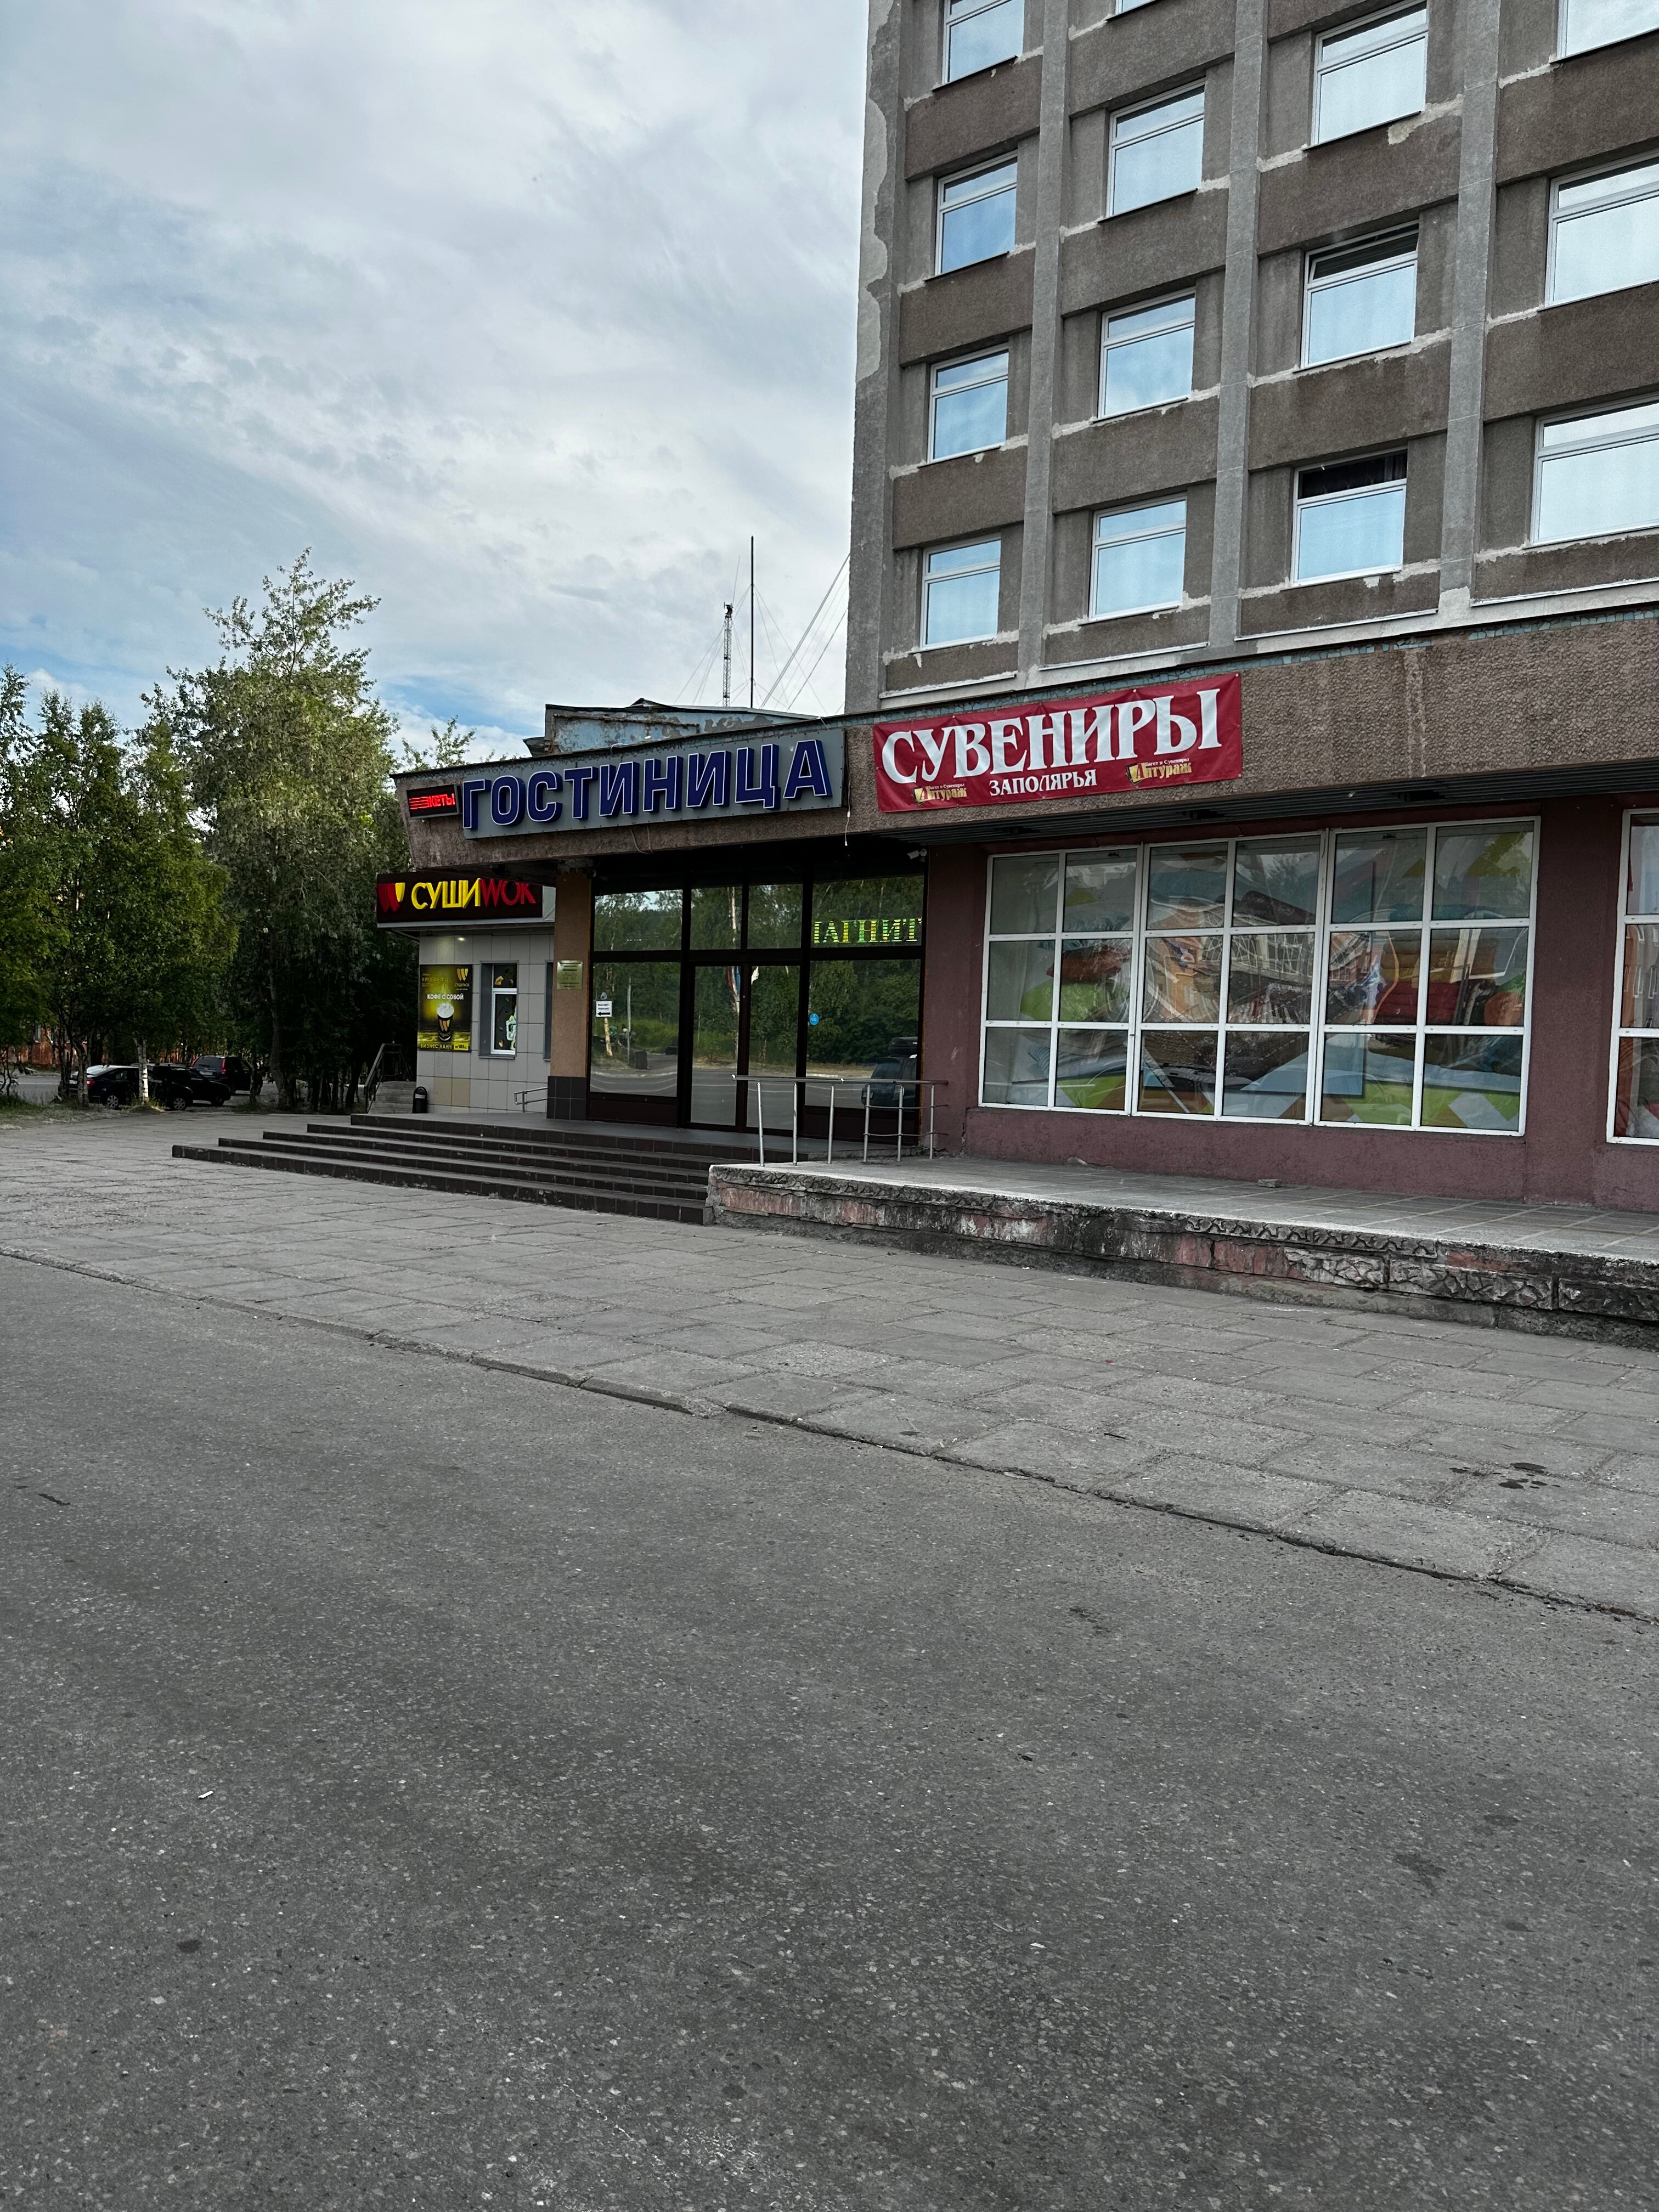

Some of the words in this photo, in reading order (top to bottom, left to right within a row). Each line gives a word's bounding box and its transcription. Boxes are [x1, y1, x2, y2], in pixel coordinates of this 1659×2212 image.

[881, 688, 1222, 784] СУВЕНИРЫ
[462, 739, 833, 830] ГОСТИНИЦА
[989, 769, 1098, 796] ЗАПОЛЯРЬЯ
[1137, 762, 1192, 780] Антураж
